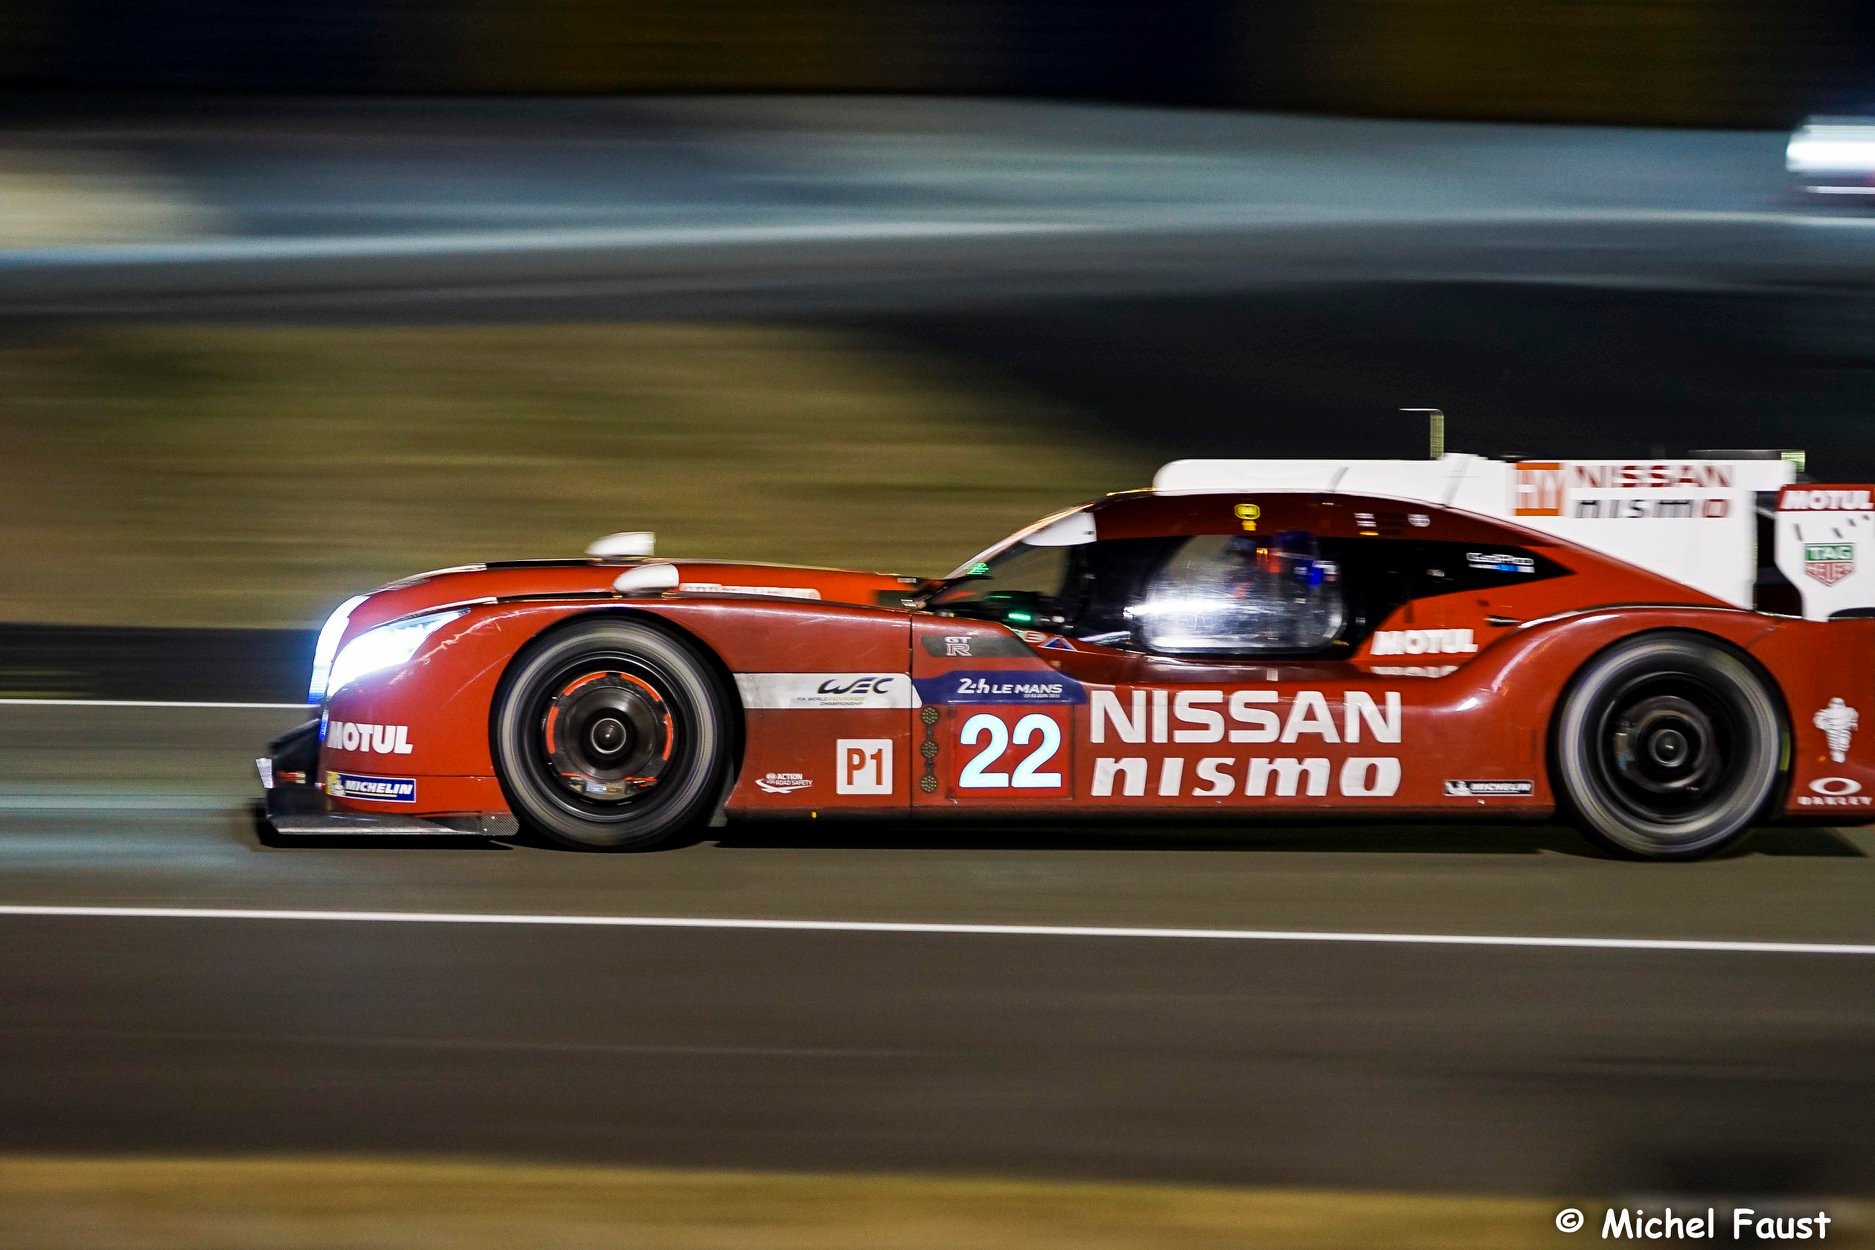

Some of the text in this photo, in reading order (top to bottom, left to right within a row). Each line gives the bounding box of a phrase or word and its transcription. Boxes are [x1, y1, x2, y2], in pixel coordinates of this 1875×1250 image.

[1573, 465, 1736, 488] NISSAN
[1575, 499, 1730, 518] nismo
[1781, 490, 1874, 510] MOTUL
[1806, 547, 1852, 560] TAG
[946, 643, 973, 657] R
[1370, 629, 1479, 655] MOTUL
[817, 676, 894, 694] WEC
[991, 684, 1013, 694] LE
[1014, 684, 1063, 694] MANS
[1090, 690, 1401, 744] NISSAN
[327, 721, 413, 754] MOTUL
[959, 713, 1061, 788] 22
[847, 748, 883, 785] P1
[345, 780, 413, 794] MICHELIN
[1091, 757, 1401, 797] nismo
[1470, 783, 1532, 791] MICHELIN
